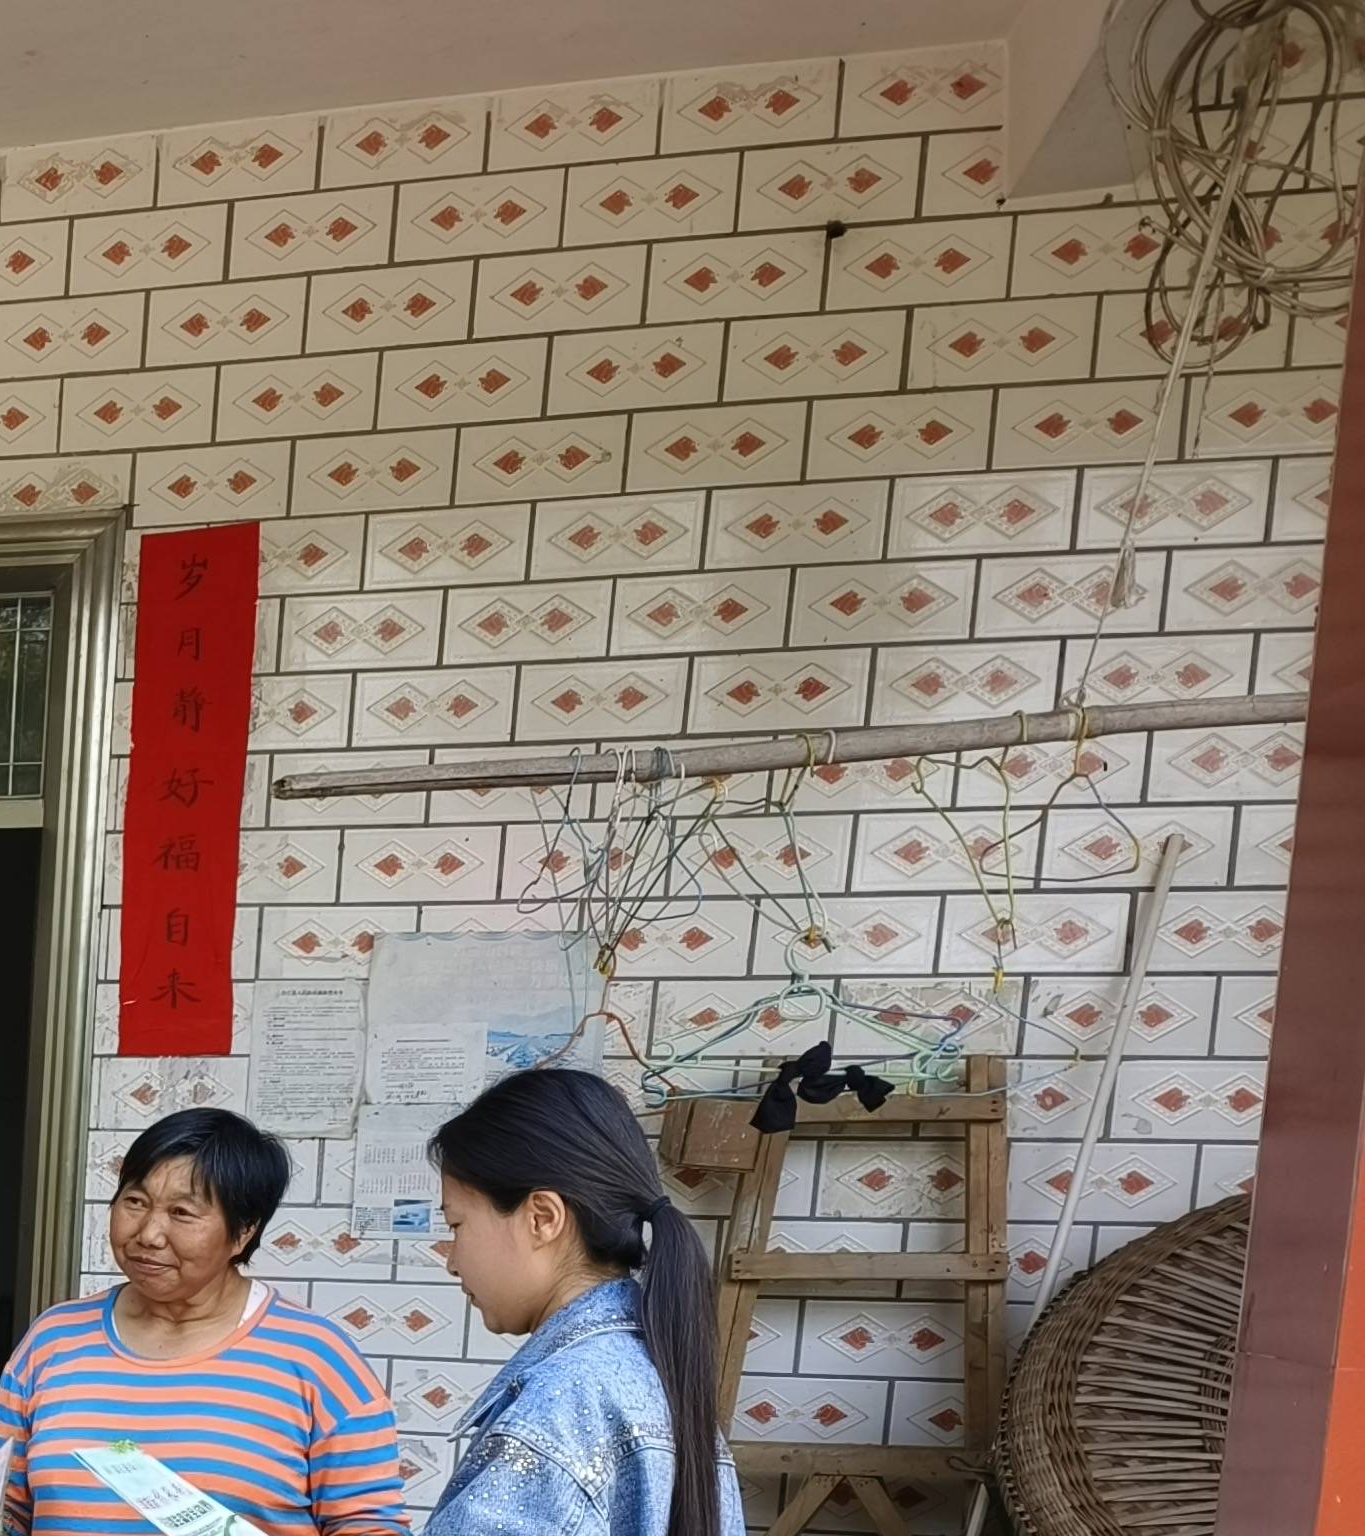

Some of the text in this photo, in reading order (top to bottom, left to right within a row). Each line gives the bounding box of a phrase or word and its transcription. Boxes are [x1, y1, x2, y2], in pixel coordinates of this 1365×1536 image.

[150, 553, 214, 1009] 岁月静好福自来
